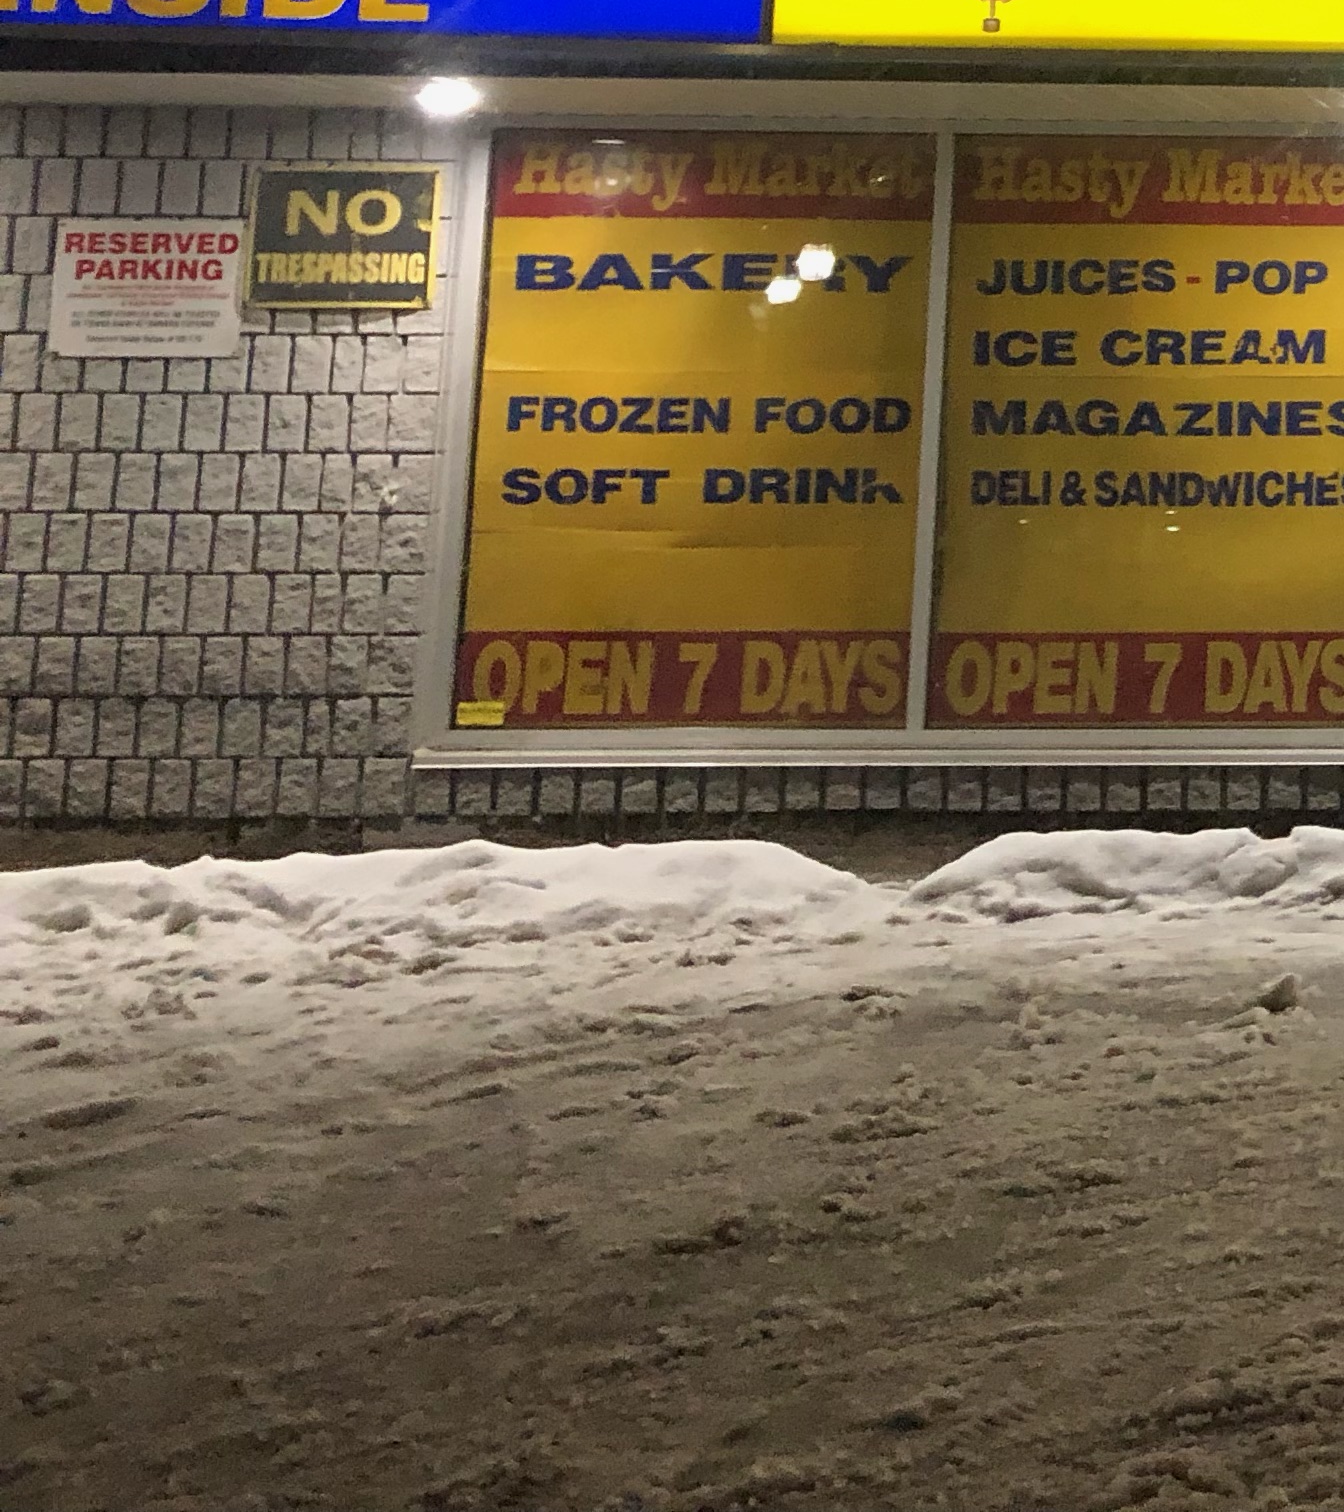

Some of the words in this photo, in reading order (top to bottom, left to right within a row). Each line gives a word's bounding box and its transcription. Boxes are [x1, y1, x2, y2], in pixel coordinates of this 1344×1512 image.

[514, 142, 694, 211] Hasty
[704, 140, 927, 197] Market
[971, 146, 1150, 218] Hasty
[286, 189, 400, 236] NO
[64, 232, 239, 254] RESERVED
[75, 259, 223, 281] PARKING
[256, 251, 426, 284] TRESPASSING
[977, 259, 1176, 296] JUICES
[1214, 260, 1328, 295] POP
[973, 330, 1077, 366] ICE
[1101, 329, 1326, 366] CREAM
[506, 396, 731, 434] FROZEN
[755, 396, 911, 434] FOOD
[501, 468, 670, 505] SOFT
[971, 471, 1051, 507] DELI
[1060, 471, 1086, 507] &
[474, 640, 653, 715] OPEN
[679, 641, 717, 714] 7
[740, 639, 902, 715] DAYS
[945, 641, 1119, 715] OPEN
[1144, 643, 1182, 714] 7
